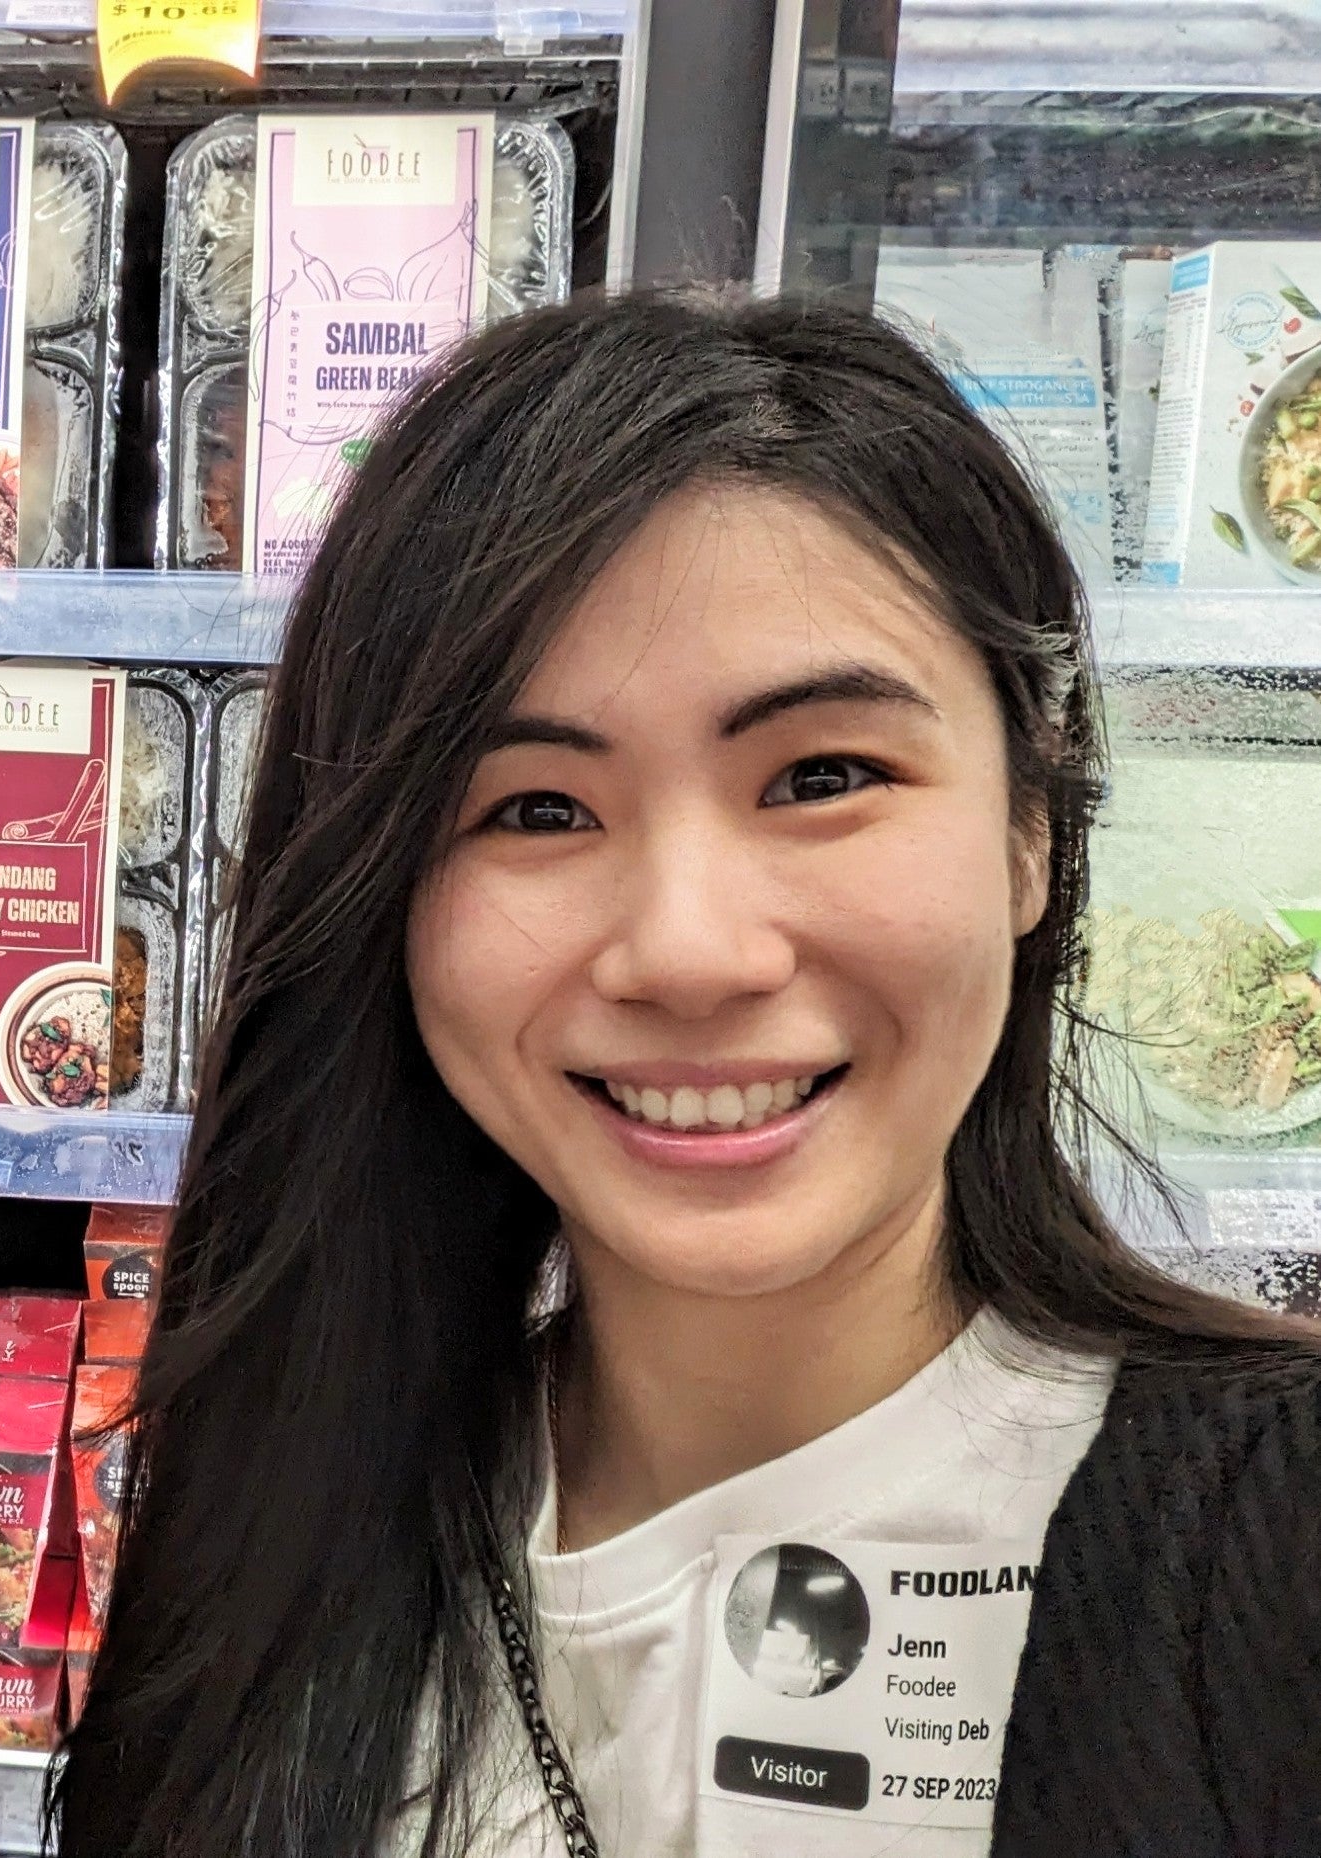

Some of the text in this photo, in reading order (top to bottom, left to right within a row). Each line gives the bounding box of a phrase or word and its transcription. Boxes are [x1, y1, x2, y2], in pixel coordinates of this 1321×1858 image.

[327, 148, 421, 176] FOODEE
[325, 321, 429, 355] SAMBAL
[315, 366, 372, 391] GREEN
[7, 898, 80, 925] CHICKEN
[113, 1271, 150, 1283] SPICE
[113, 1283, 149, 1292] spoon
[890, 1565, 1041, 1597] FOODLAN
[887, 1633, 947, 1659] Jenn
[887, 1674, 957, 1697] Foodee
[885, 1717, 990, 1746] Visiting Deb
[750, 1756, 829, 1788] Visitor
[882, 1775, 996, 1801] 27 SEP 2023
